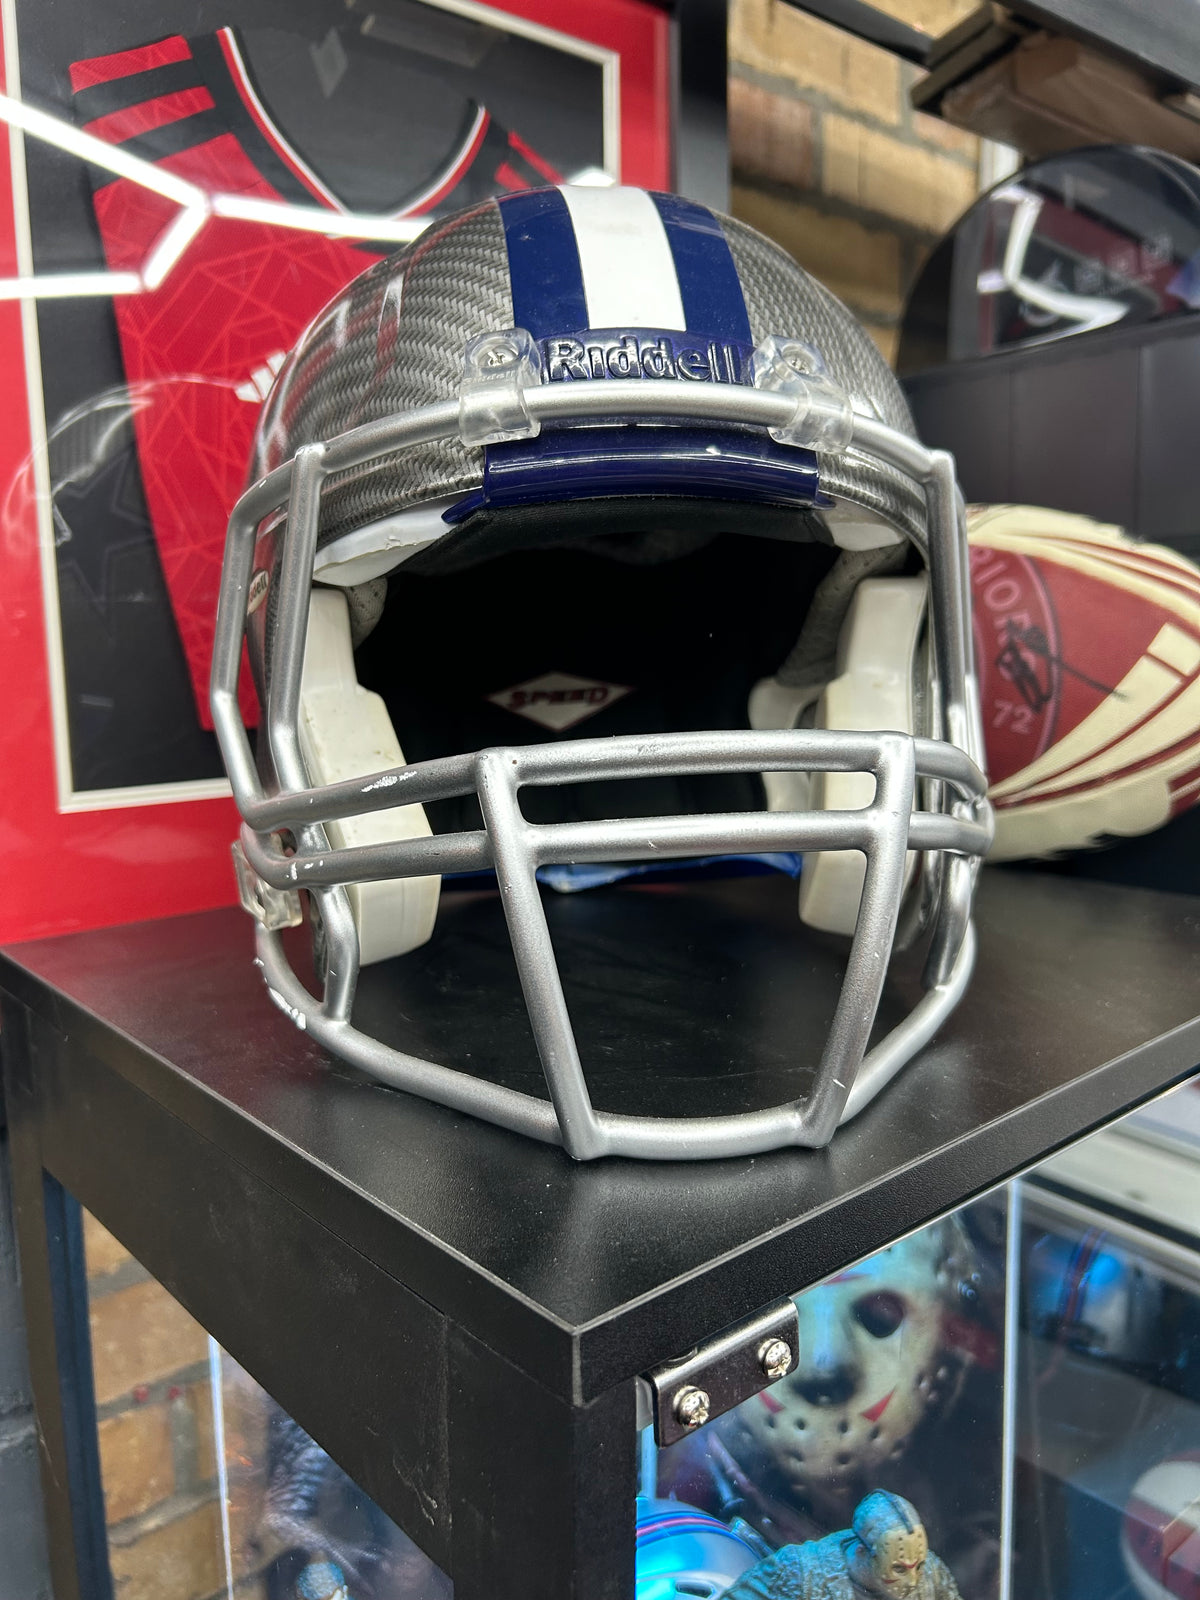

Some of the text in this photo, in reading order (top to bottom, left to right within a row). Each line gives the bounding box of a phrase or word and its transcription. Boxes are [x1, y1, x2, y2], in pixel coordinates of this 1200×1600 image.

[547, 335, 743, 384] Riddell
[509, 687, 609, 710] SPEED
[992, 699, 1032, 735] 72
